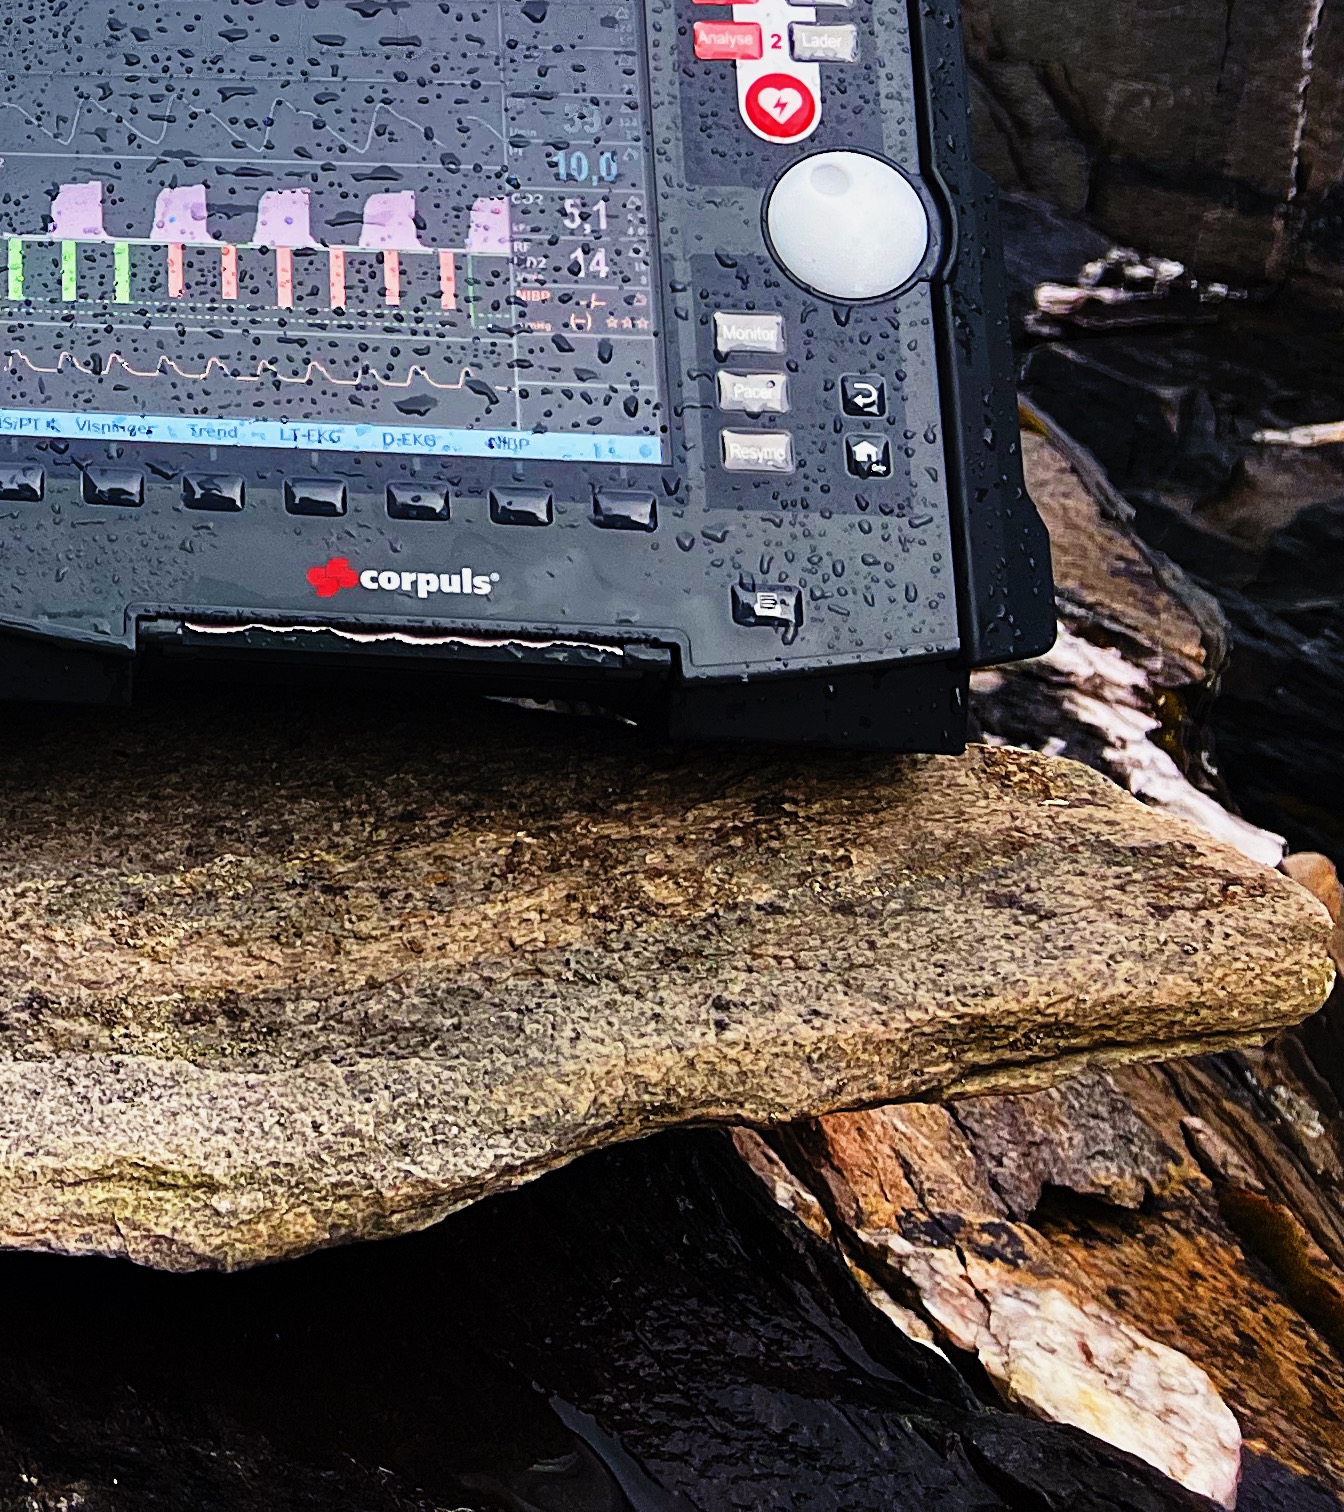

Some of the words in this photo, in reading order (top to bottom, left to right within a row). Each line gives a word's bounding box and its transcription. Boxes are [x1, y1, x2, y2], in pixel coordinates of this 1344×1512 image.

[697, 31, 753, 48] Analyse
[770, 34, 782, 50] 2
[801, 33, 842, 48] Lader
[722, 325, 776, 341] Monitor
[190, 422, 239, 440] Trend
